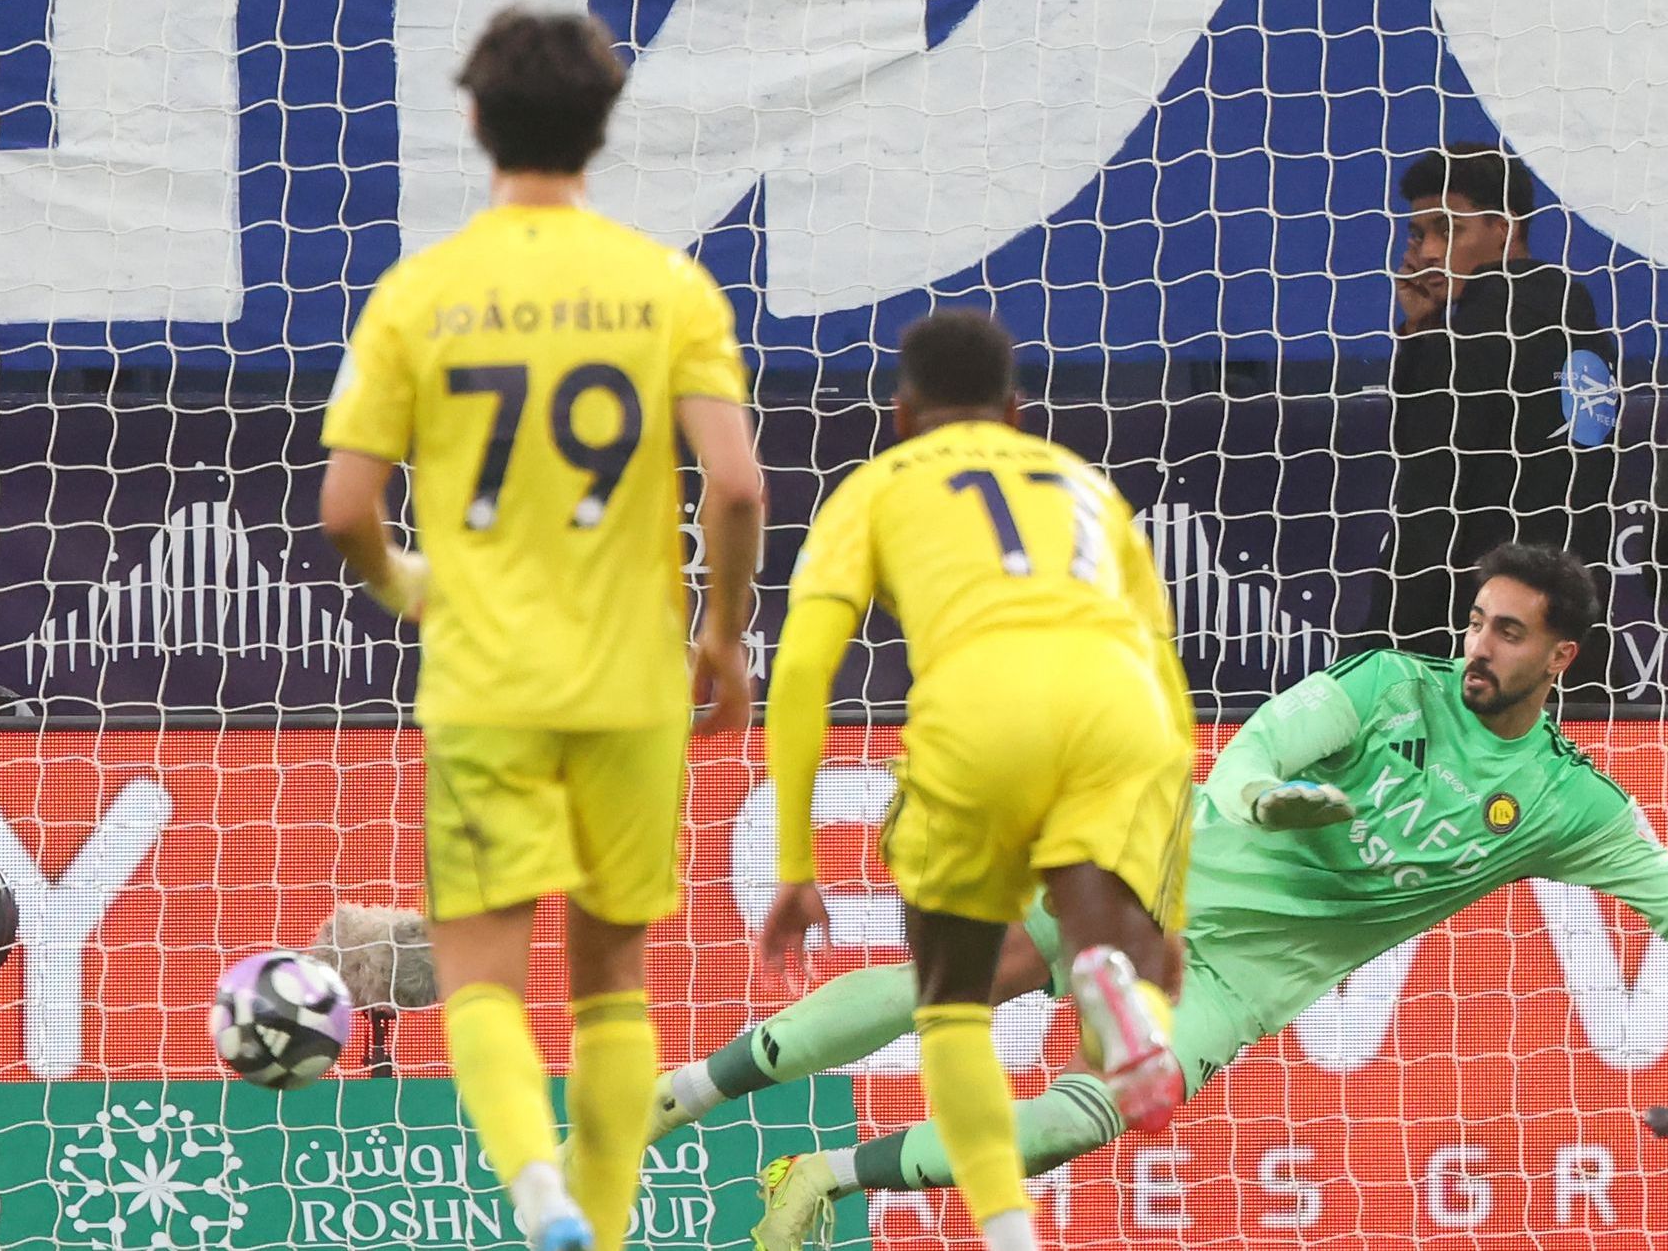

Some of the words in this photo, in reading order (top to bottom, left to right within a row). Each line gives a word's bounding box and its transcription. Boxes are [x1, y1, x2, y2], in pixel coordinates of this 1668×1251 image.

[551, 288, 654, 331] FÉLIX
[443, 362, 644, 531] 79
[942, 468, 1102, 585] 17
[295, 1127, 468, 1186] روشن
[300, 1199, 503, 1241] ROSHN
